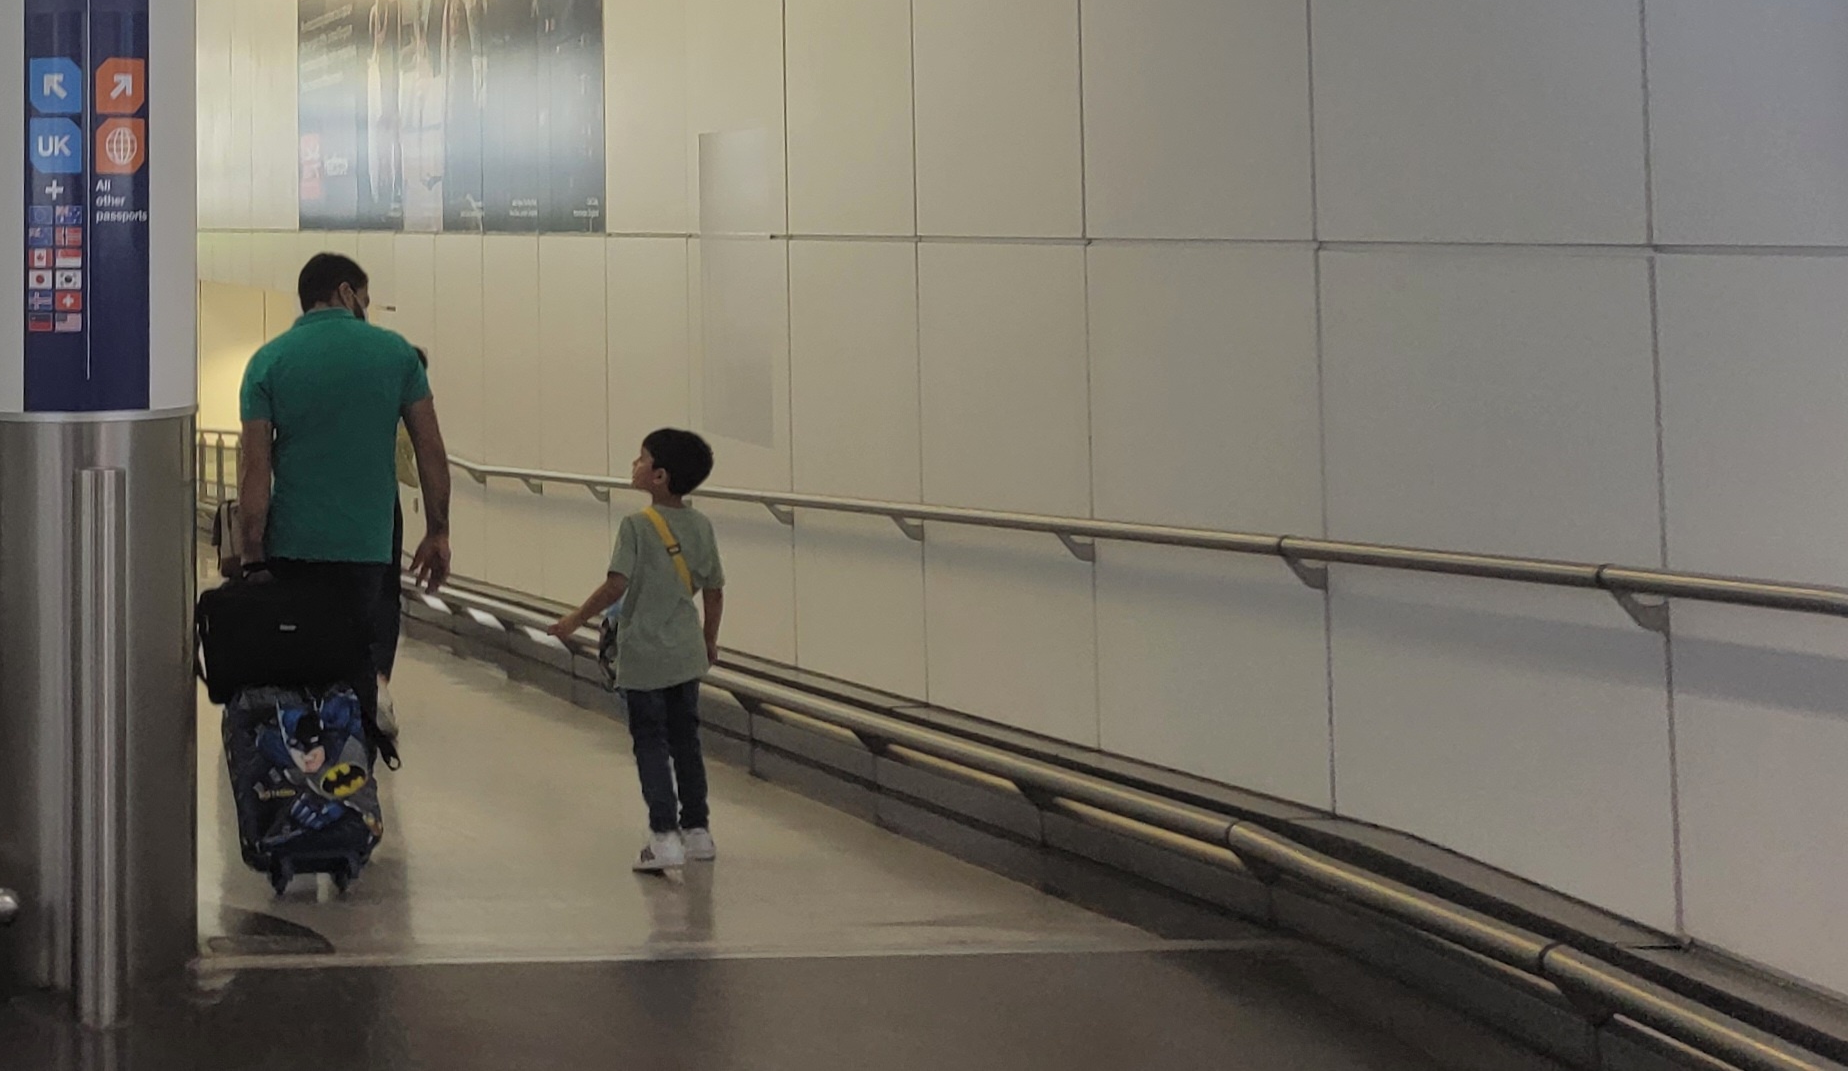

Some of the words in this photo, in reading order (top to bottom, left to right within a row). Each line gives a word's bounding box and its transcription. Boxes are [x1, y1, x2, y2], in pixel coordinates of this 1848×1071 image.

[38, 135, 72, 157] UK
[95, 180, 111, 192] All
[95, 195, 126, 207] other
[95, 209, 148, 224] passports
